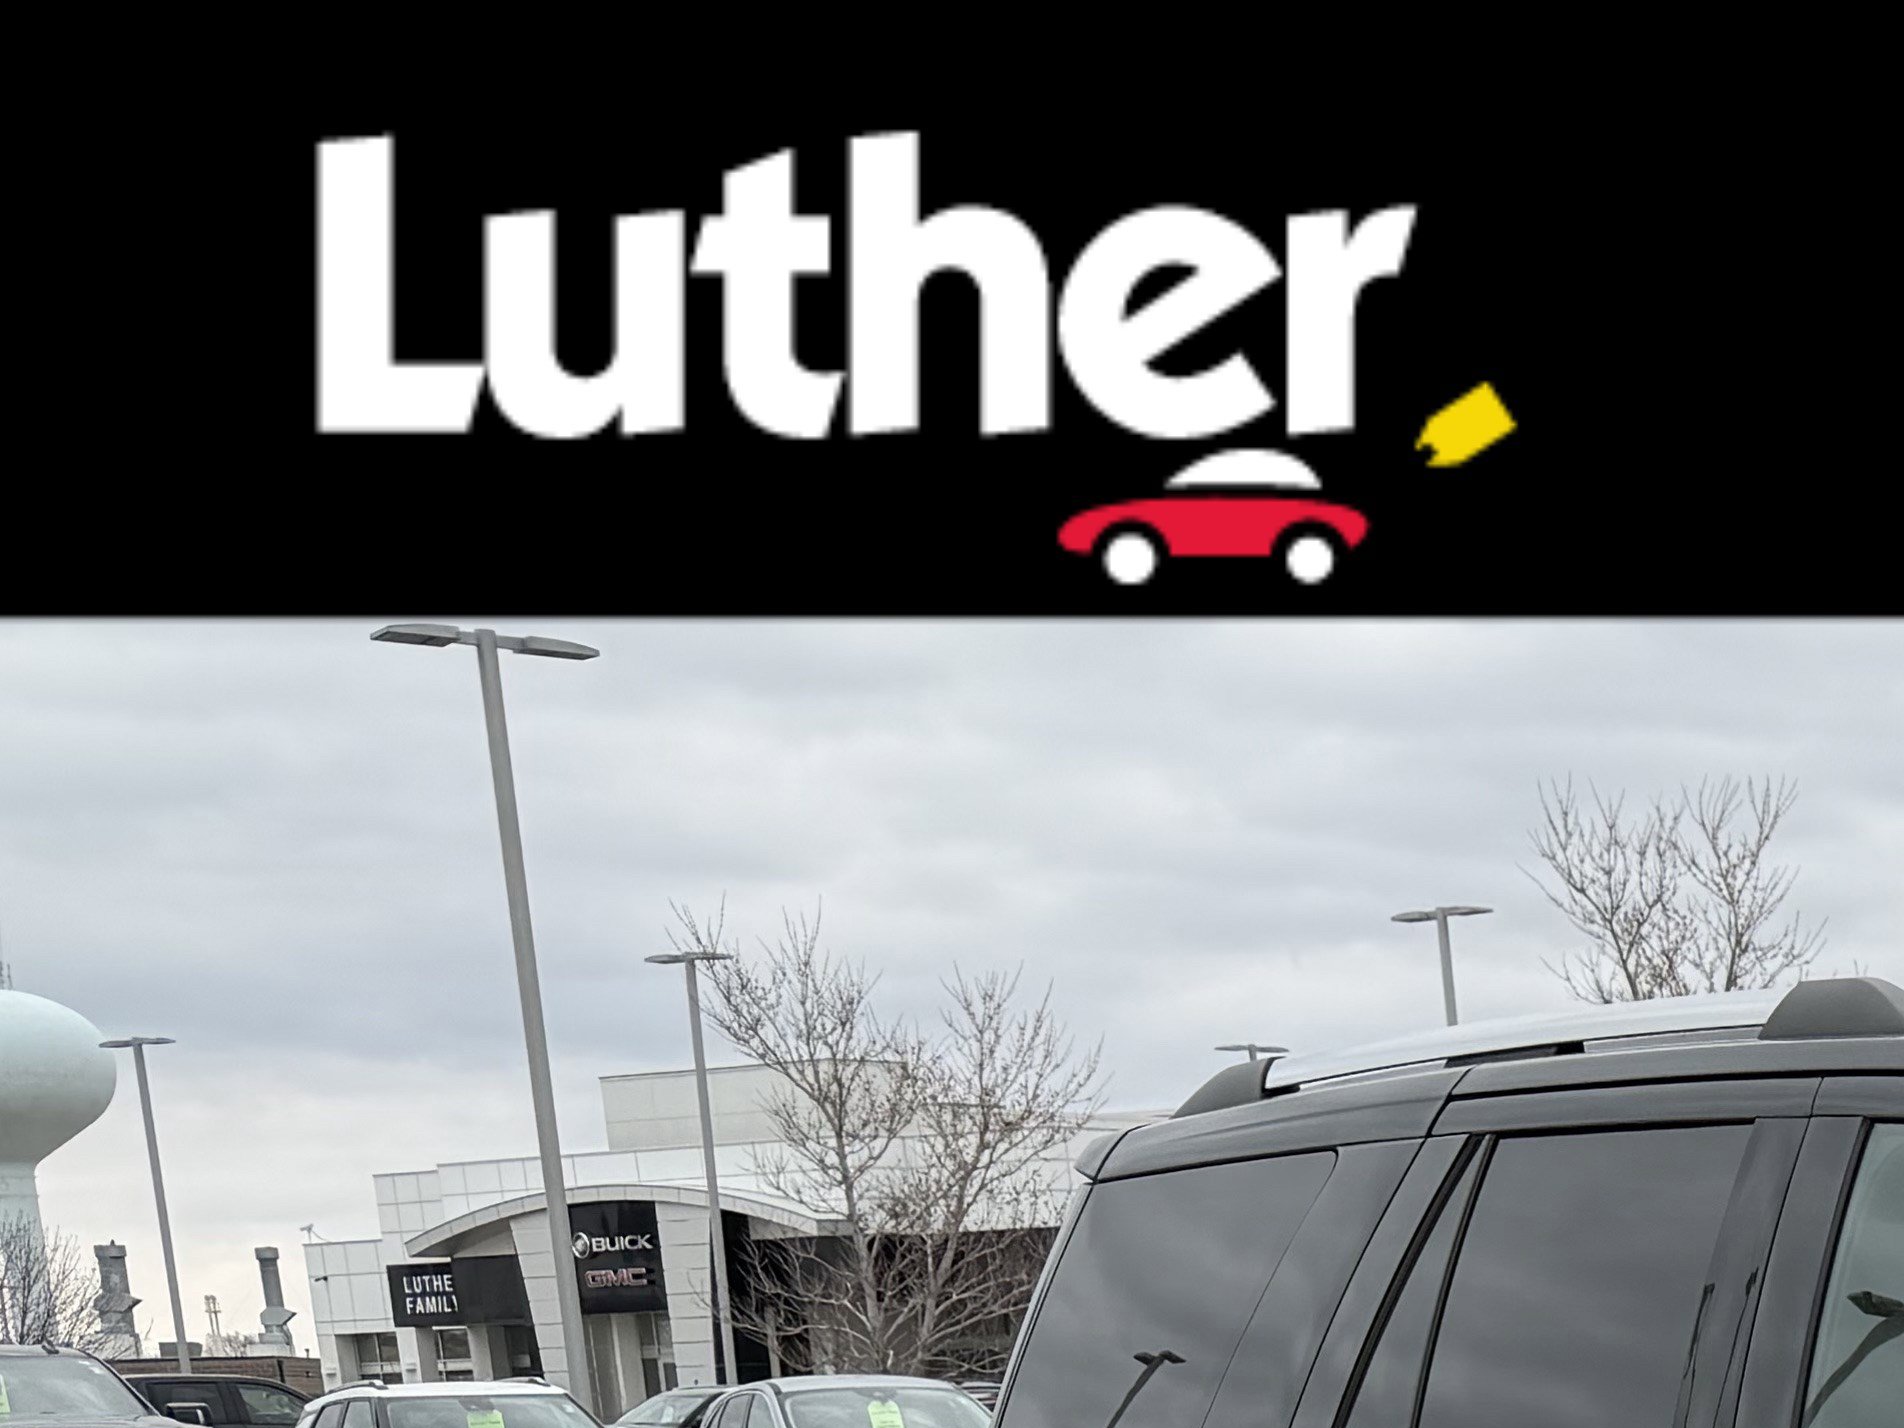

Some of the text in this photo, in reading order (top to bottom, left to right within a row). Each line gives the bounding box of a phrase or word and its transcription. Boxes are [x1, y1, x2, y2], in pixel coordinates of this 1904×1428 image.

[591, 1234, 654, 1252] BUICK
[402, 1274, 454, 1293] LUTHE
[585, 1267, 648, 1288] GMC
